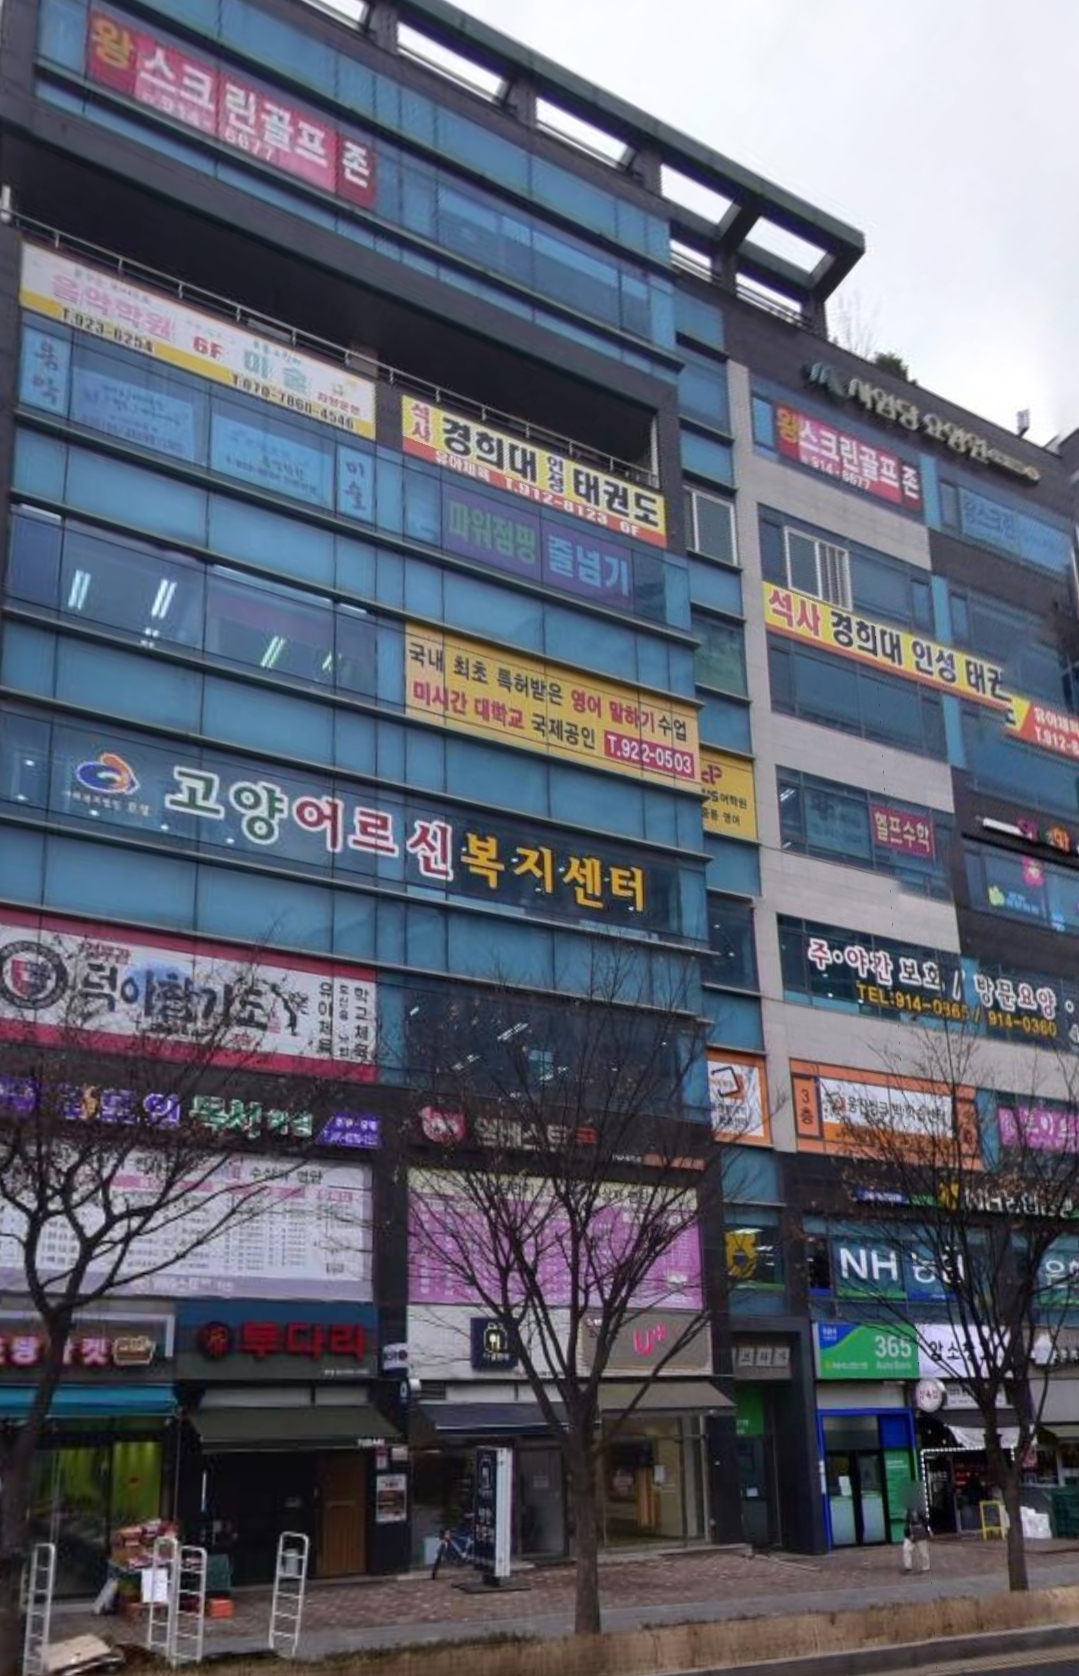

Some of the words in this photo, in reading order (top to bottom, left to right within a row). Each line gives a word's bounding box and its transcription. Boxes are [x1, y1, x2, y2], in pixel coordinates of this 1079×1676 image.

[442, 416, 538, 483] 경희대
[573, 467, 658, 527] 태권도
[547, 535, 629, 598] 줄넘기
[769, 589, 820, 636] 석사
[831, 610, 902, 665] 경희대
[911, 639, 957, 683] 인성
[409, 642, 443, 673] 국내
[453, 655, 487, 685] 최초
[497, 668, 563, 705] 특허받은
[570, 688, 601, 719] 영어
[609, 700, 655, 734] 말하기
[658, 713, 686, 742] 수업
[413, 681, 466, 711] 미시간
[475, 697, 524, 729] 대학교
[532, 713, 595, 750] 국제공인
[608, 732, 692, 773] T.922-0503
[841, 1248, 898, 1282] NH
[875, 1335, 912, 1358] 365
